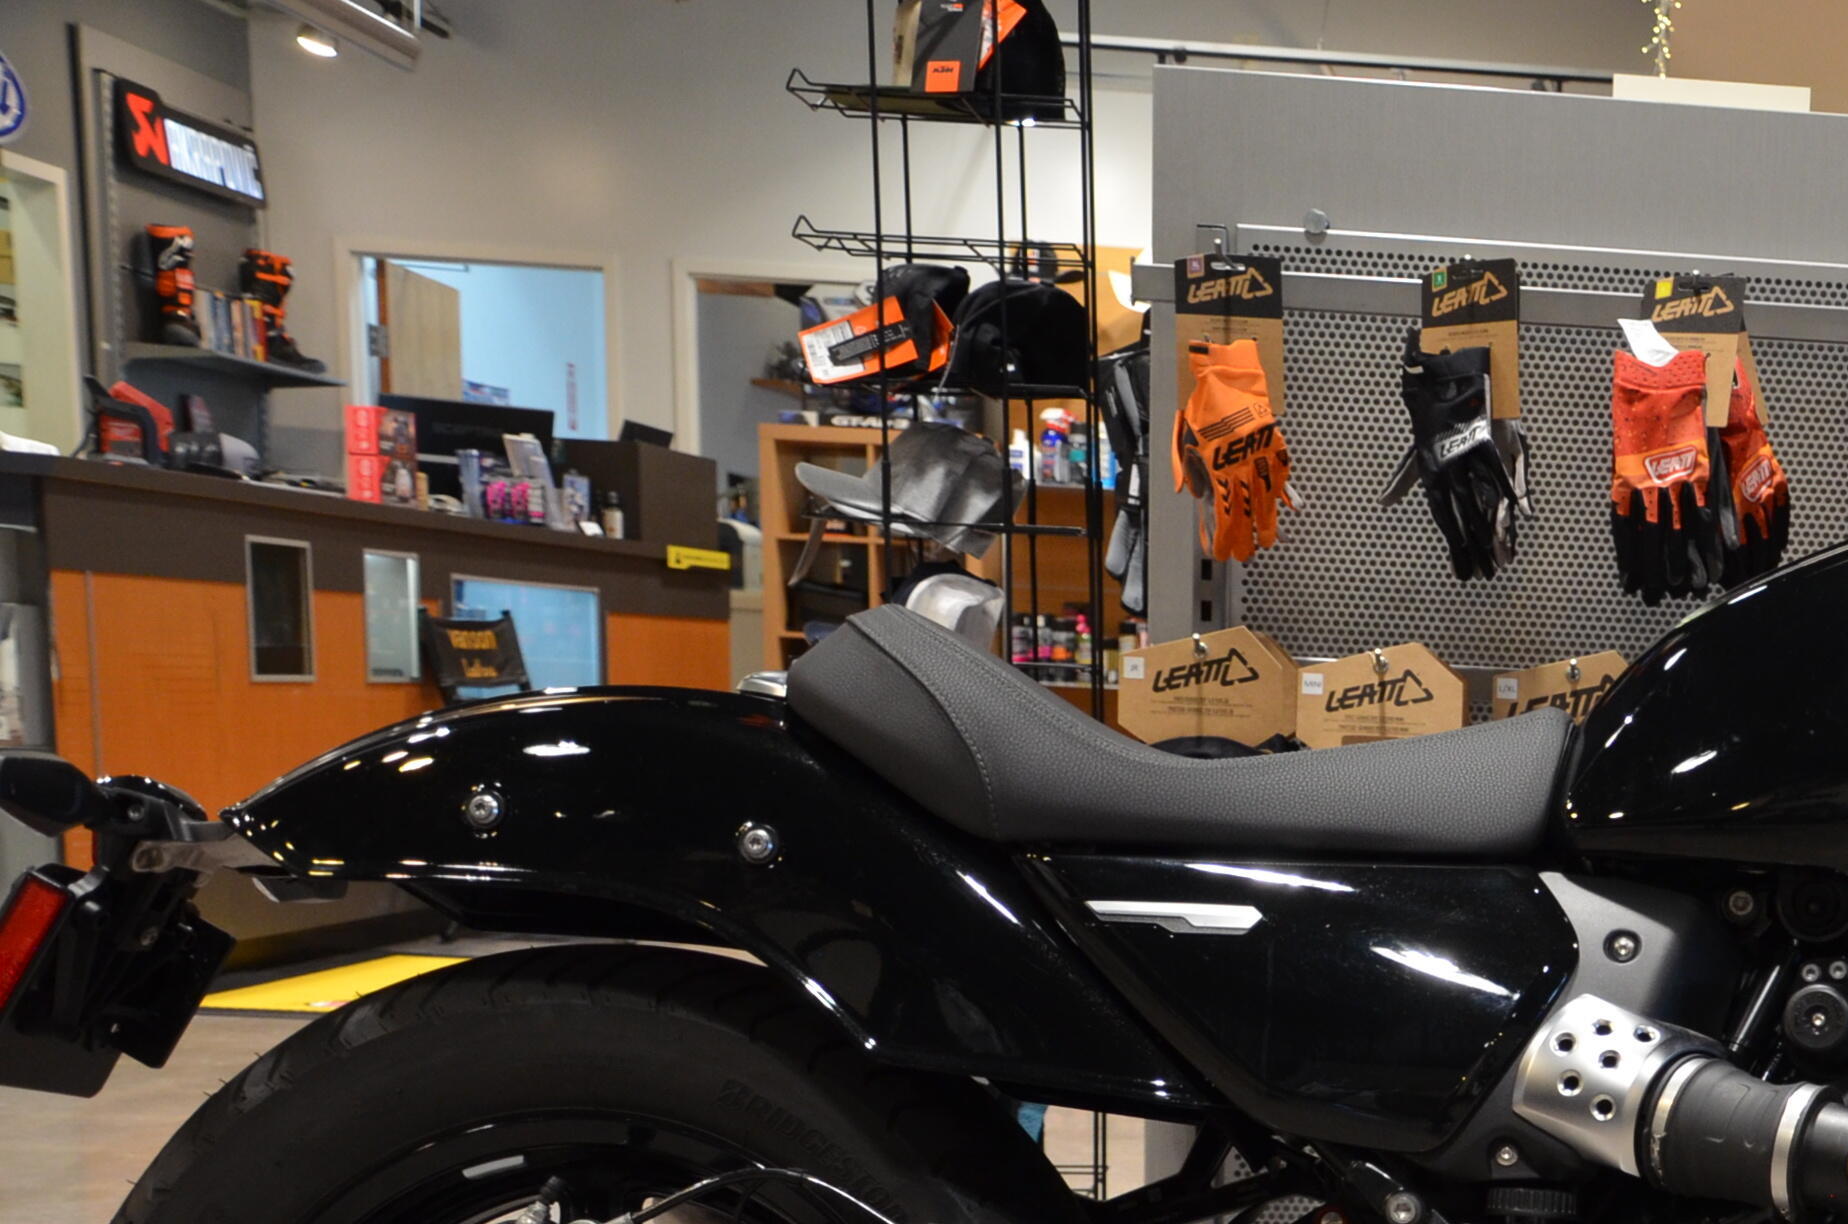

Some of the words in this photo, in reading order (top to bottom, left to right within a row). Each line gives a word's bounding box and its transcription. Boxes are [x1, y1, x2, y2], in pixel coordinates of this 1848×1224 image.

[1187, 273, 1251, 304] LEATT
[1432, 278, 1486, 317] LEATT
[1651, 292, 1714, 323] LEATT
[1152, 657, 1229, 692] LEATT
[1325, 678, 1402, 712] LEATT
